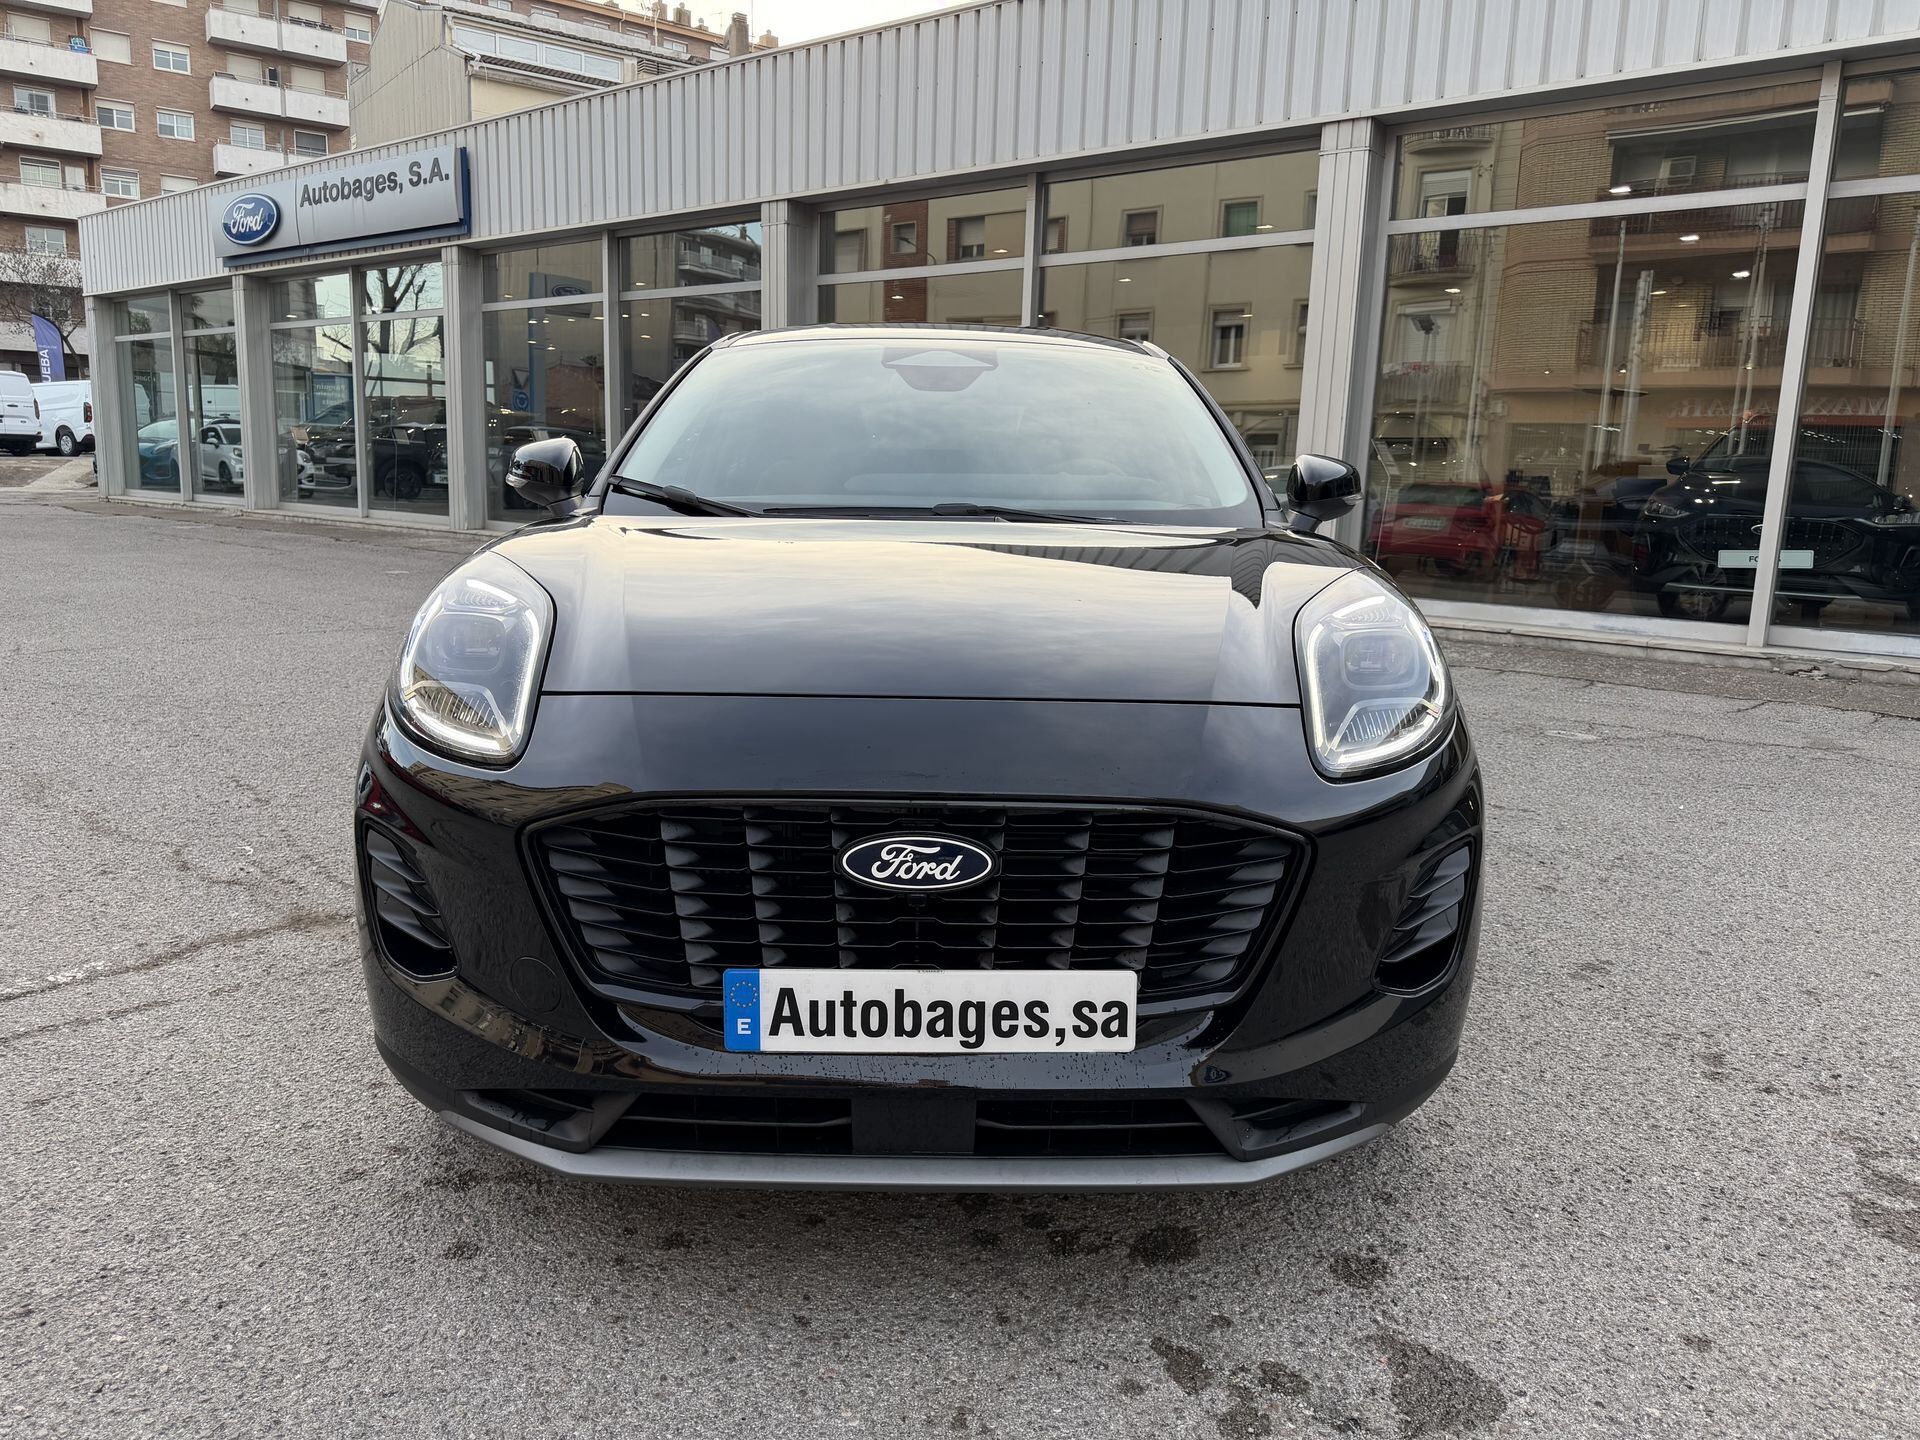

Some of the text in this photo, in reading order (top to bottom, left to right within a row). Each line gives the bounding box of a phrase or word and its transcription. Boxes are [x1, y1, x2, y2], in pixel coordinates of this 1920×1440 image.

[300, 157, 450, 207] Autobages, S.A.
[230, 203, 264, 233] Ford
[871, 843, 961, 882] Ford
[737, 1018, 751, 1035] E
[768, 986, 1129, 1050] Autobages,sa
